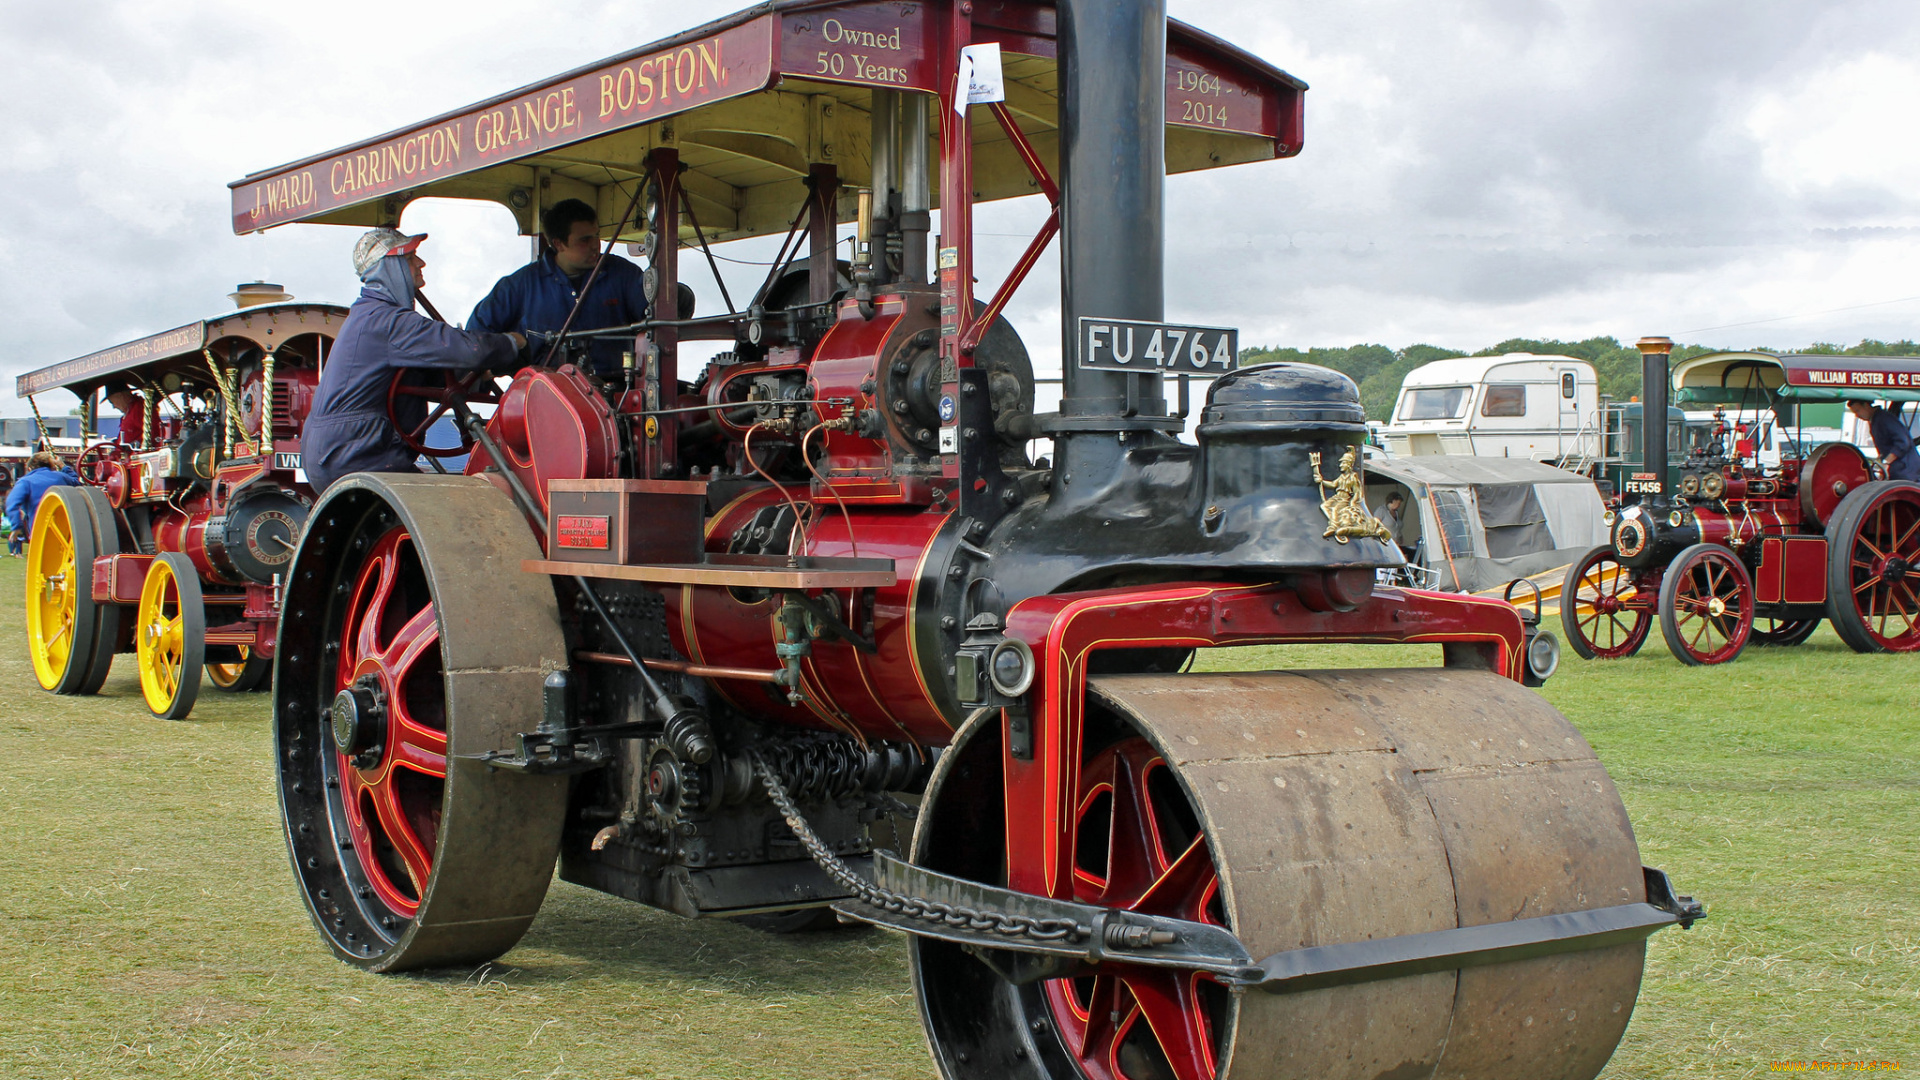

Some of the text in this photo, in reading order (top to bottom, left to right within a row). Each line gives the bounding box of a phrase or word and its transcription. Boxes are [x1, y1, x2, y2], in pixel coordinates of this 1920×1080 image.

[822, 18, 901, 51] Owned
[816, 51, 908, 84] 50 Years
[251, 38, 726, 219] J. WARD, CARRINGTON GRANGE, BOSTON.
[1182, 100, 1228, 128] 2014
[56, 365, 69, 381] SON
[69, 355, 99, 377] HAULAGE
[99, 341, 149, 368] CONTRACTORS
[153, 330, 190, 353] CUMNOCK
[1088, 325, 1231, 370] FU 4764
[1808, 370, 1847, 384] WILLIAM
[1851, 372, 1884, 385] FOSTER
[1887, 373, 1895, 385] &
[281, 454, 300, 467] VN
